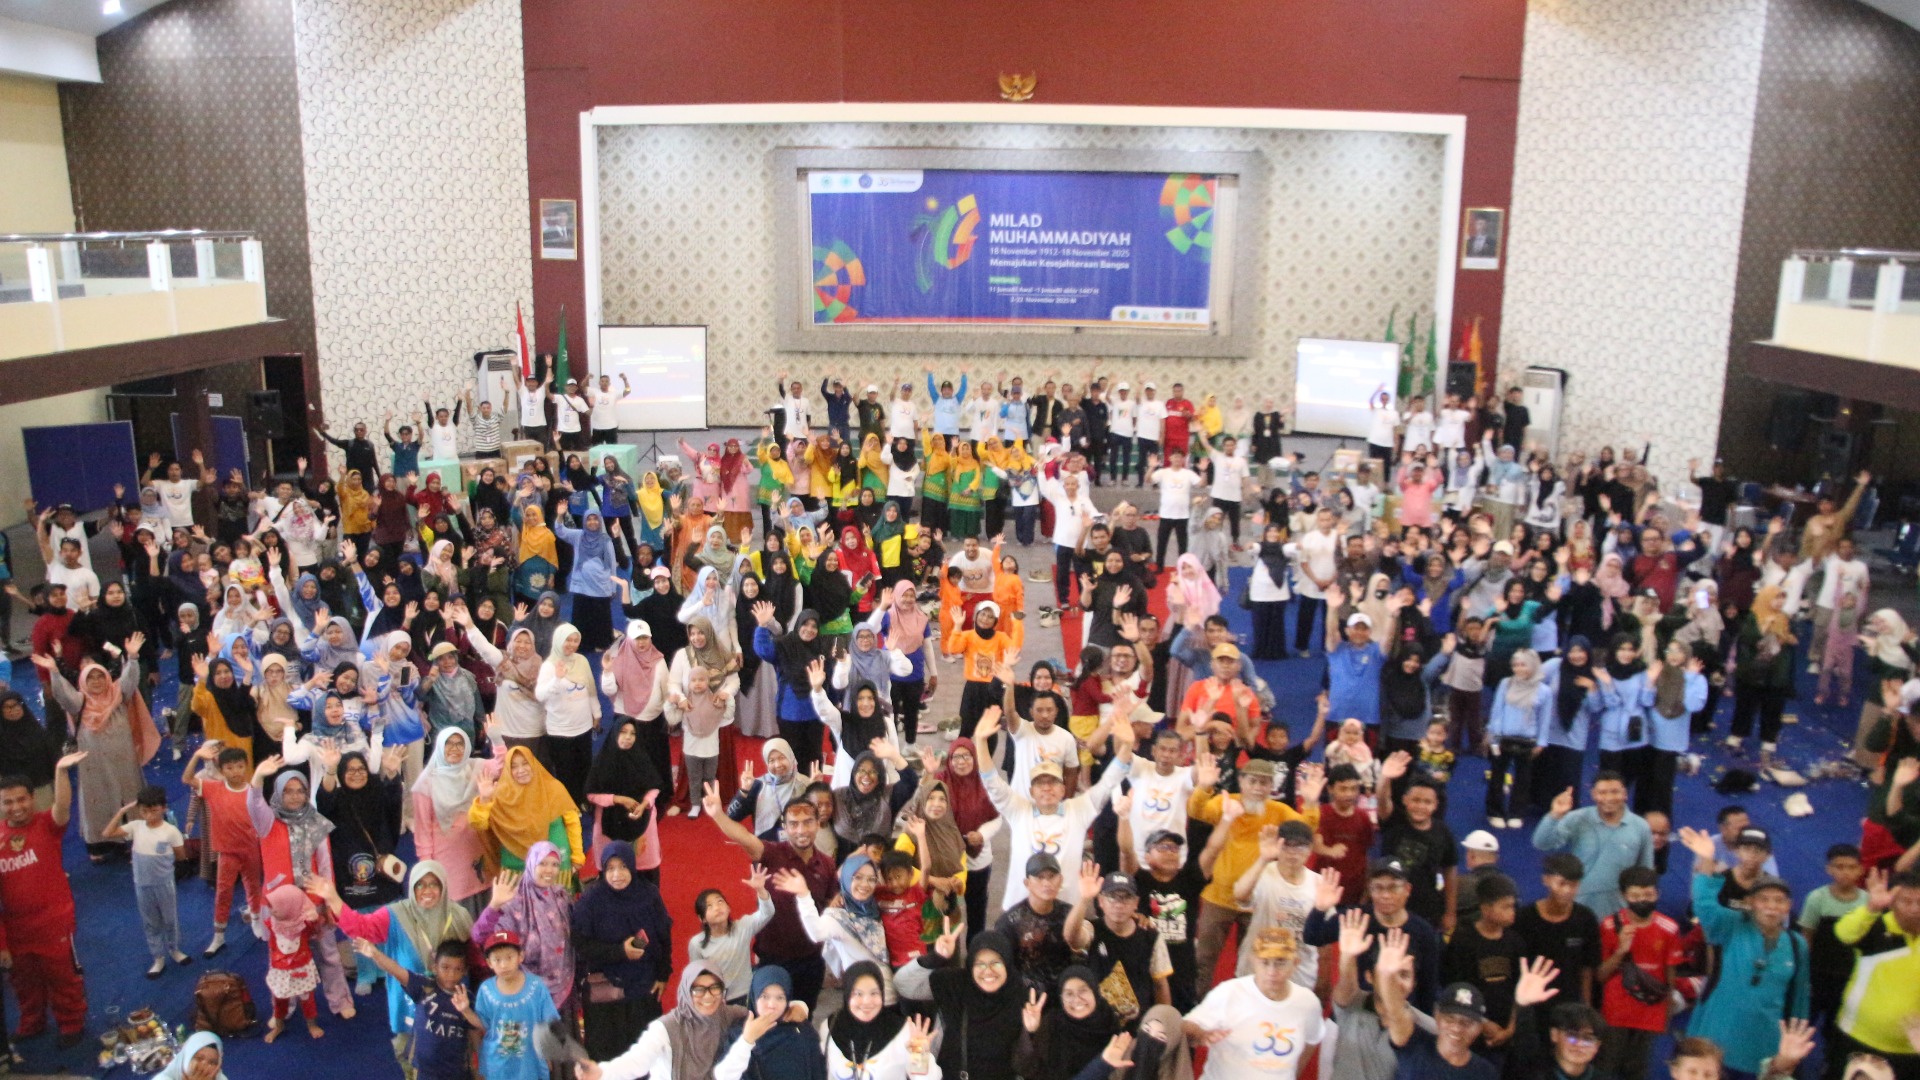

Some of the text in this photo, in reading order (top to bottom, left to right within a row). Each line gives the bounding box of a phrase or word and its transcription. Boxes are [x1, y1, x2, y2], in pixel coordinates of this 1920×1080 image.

[990, 213, 1042, 228] MILAD
[990, 230, 1131, 246] MUHAMMADIYAH
[1001, 247, 1037, 256] November
[1072, 248, 1109, 258] November
[1111, 249, 1130, 258] 2025
[990, 259, 1130, 271] Memajukan Kesejahteraan Bangsa
[1144, 788, 1174, 811] 35
[1252, 1021, 1297, 1057] 35
